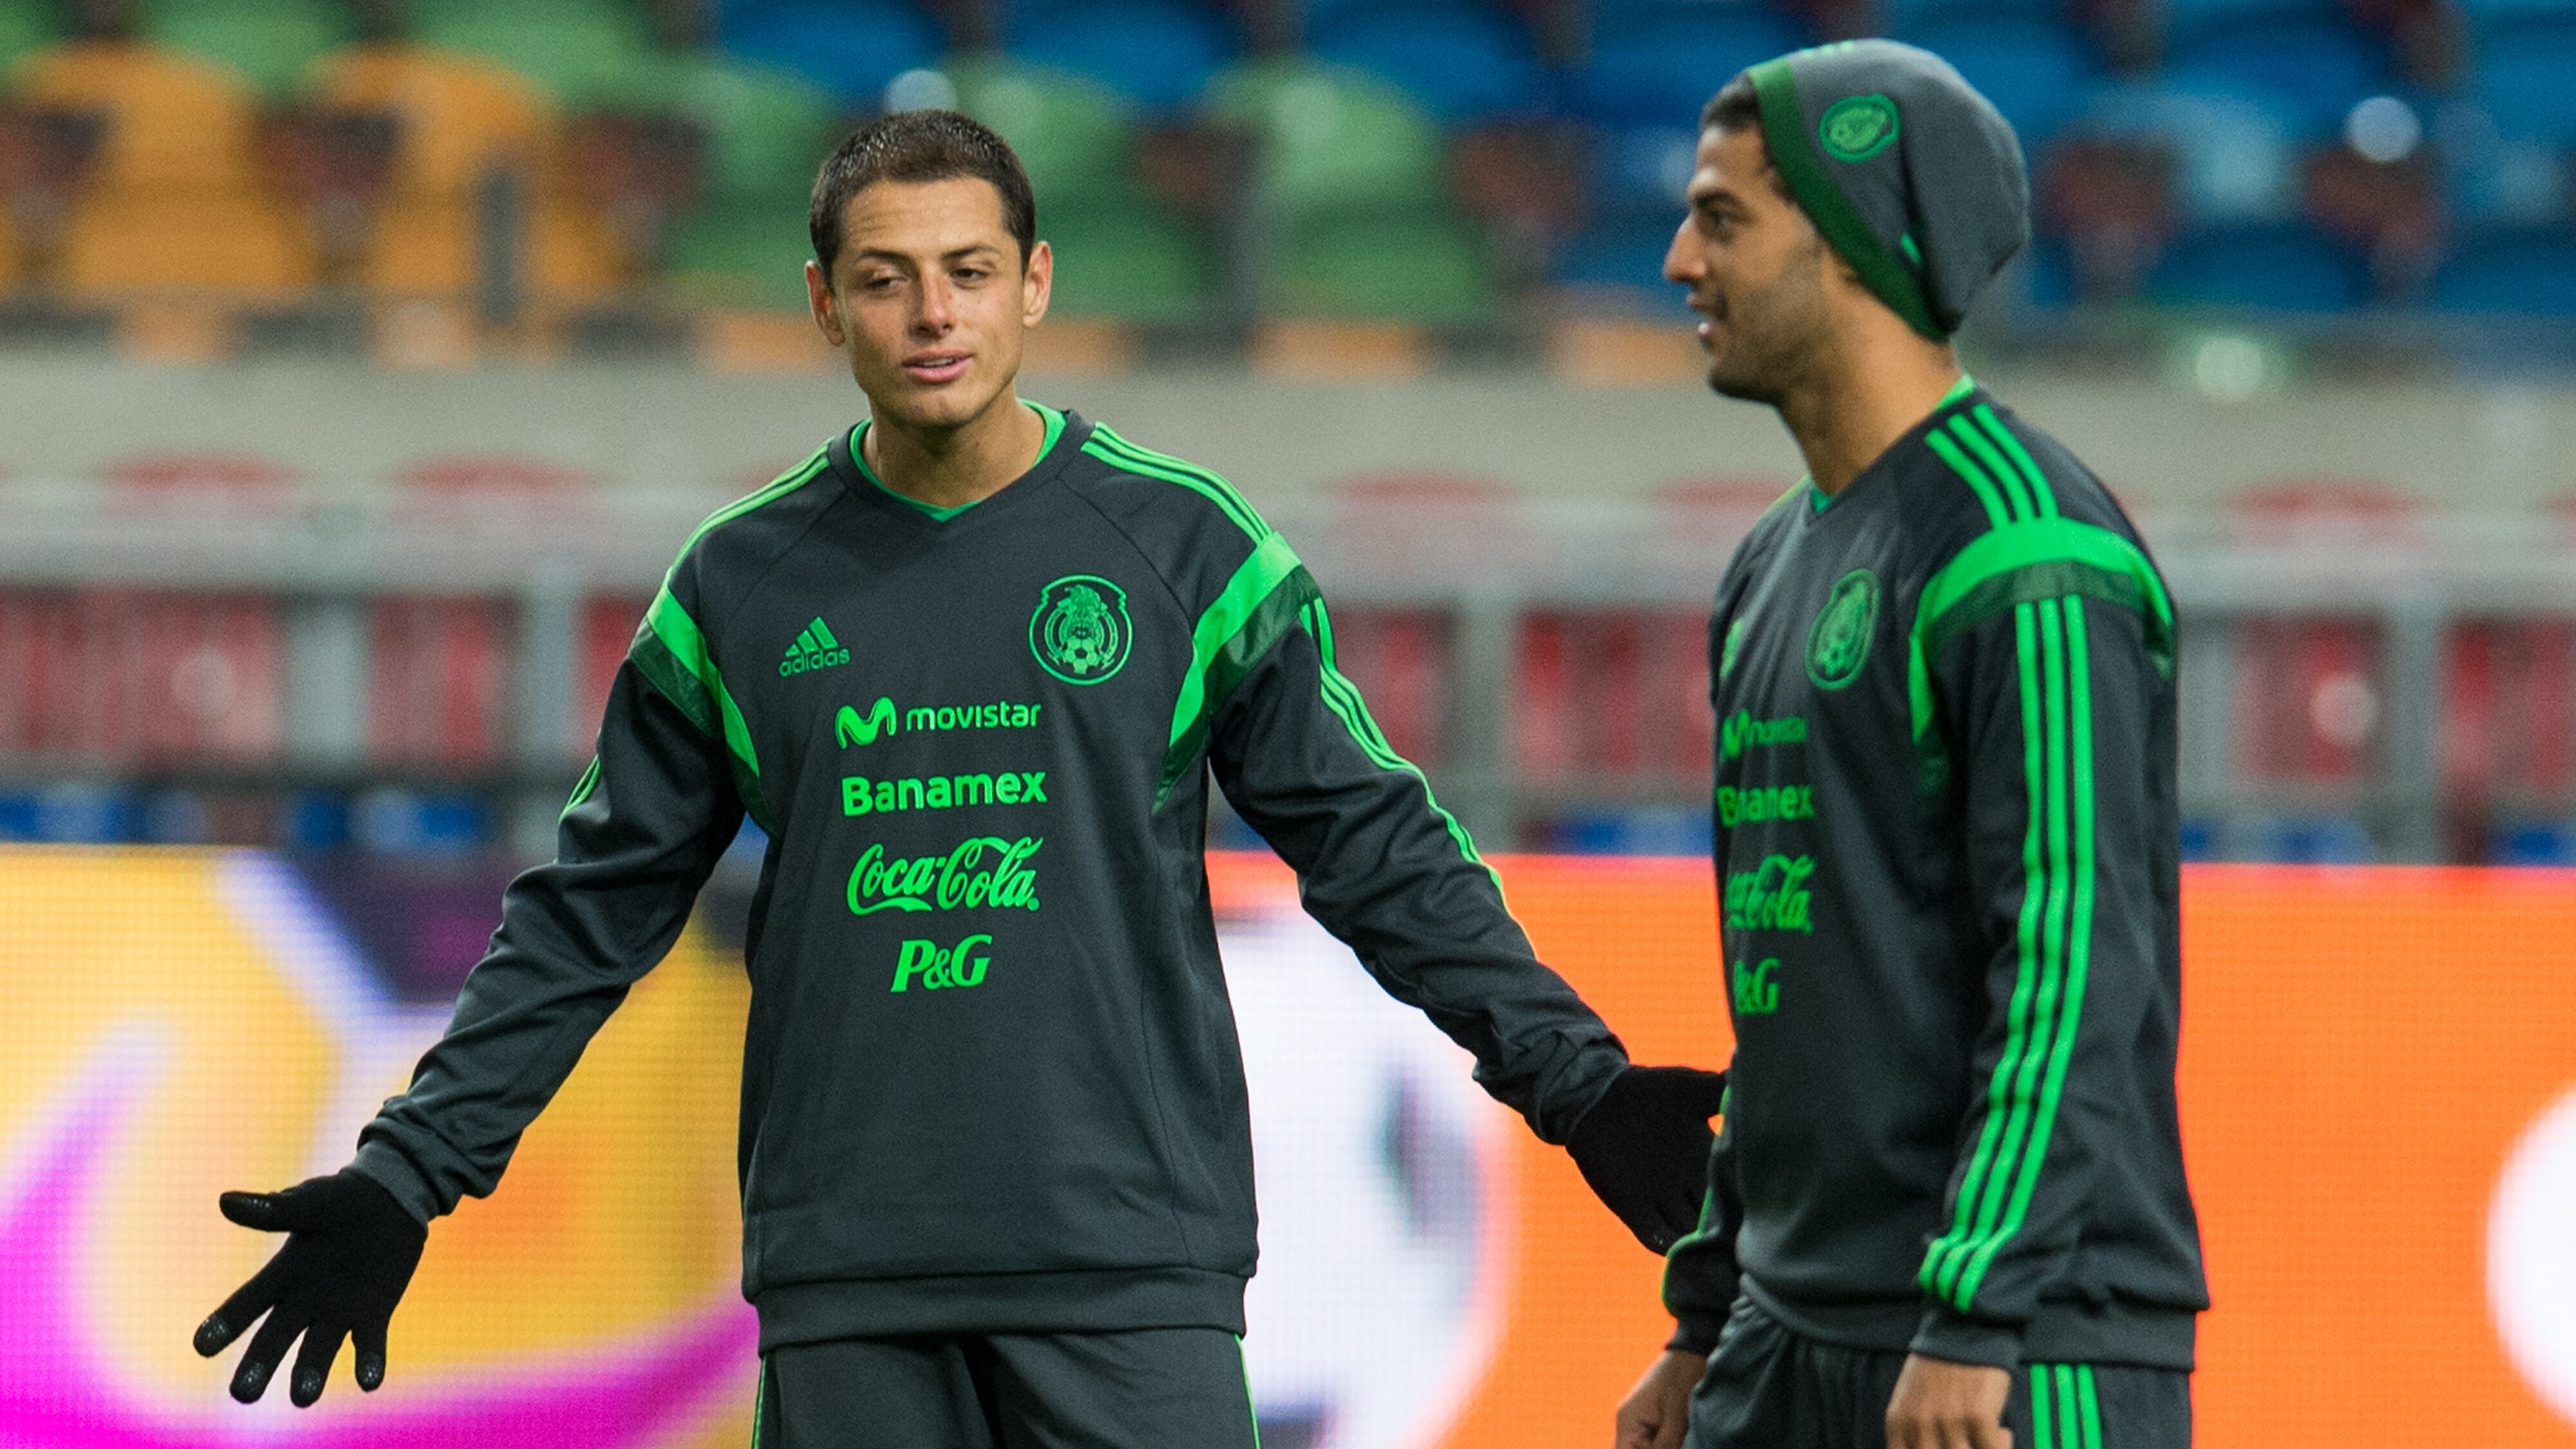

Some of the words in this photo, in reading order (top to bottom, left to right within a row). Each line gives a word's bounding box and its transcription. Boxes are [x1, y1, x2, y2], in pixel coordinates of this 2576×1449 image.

[779, 647, 851, 677] adidas
[904, 701, 1041, 732] movistar
[840, 770, 1048, 817] Banamex
[846, 835, 1044, 917] Coca-Cola
[889, 933, 994, 994] P&G
